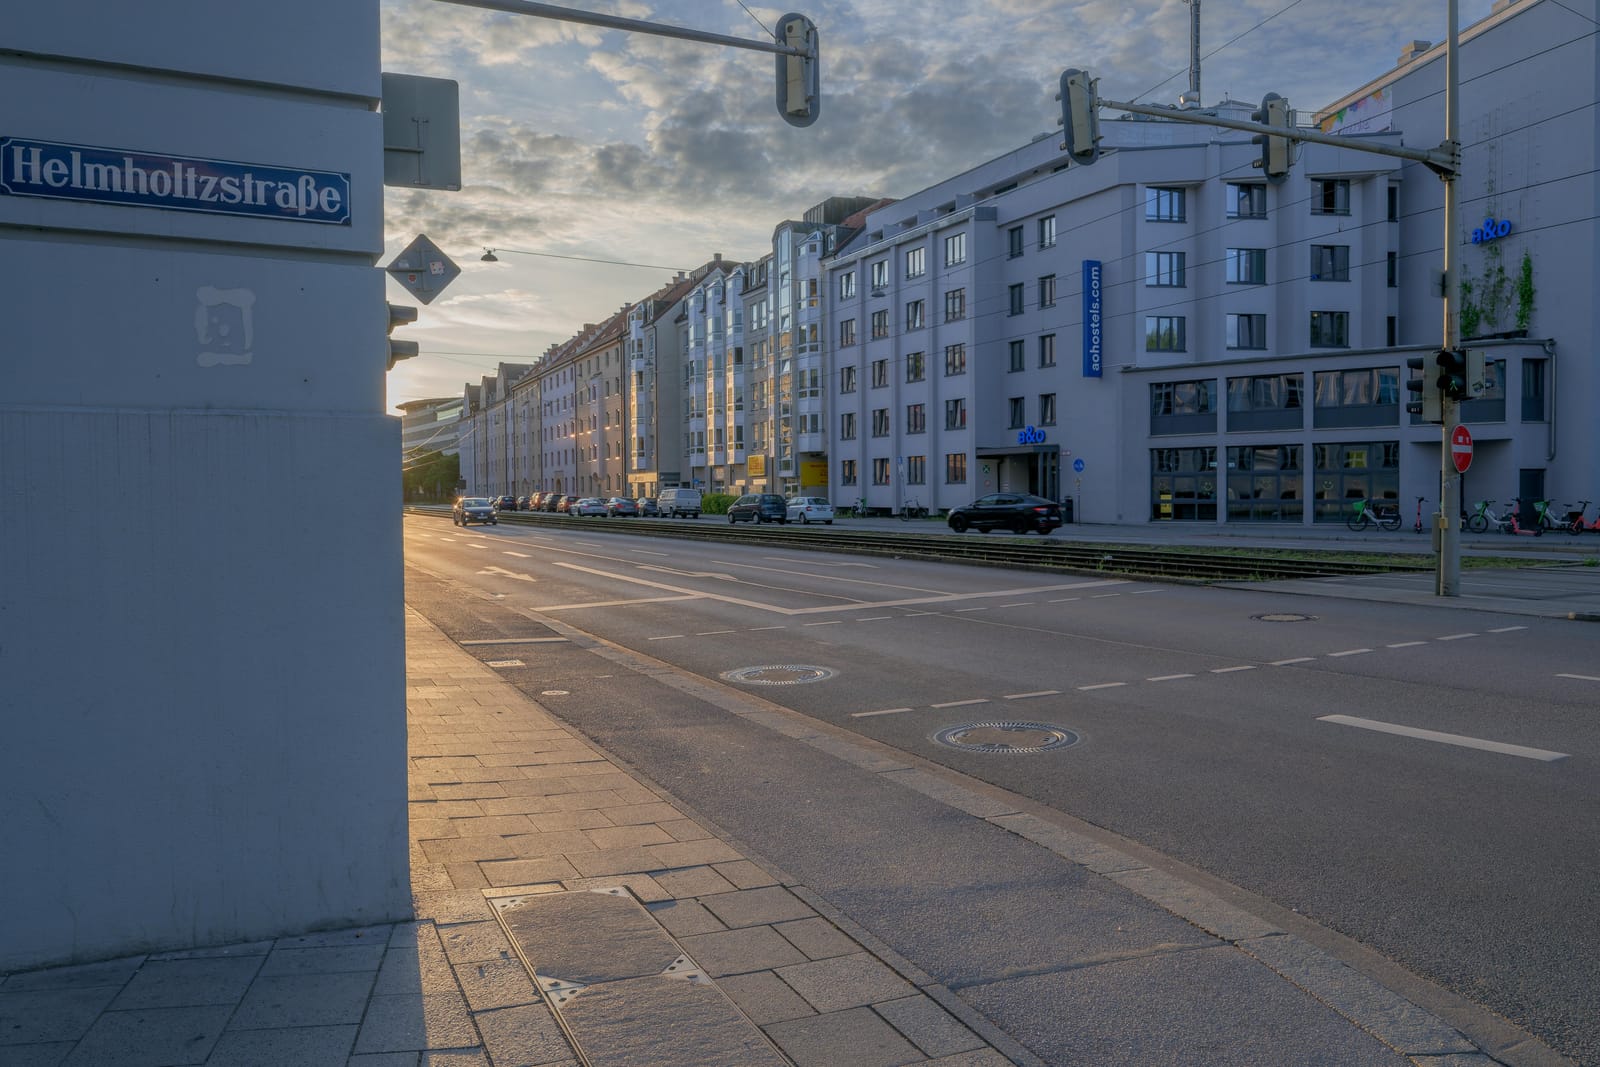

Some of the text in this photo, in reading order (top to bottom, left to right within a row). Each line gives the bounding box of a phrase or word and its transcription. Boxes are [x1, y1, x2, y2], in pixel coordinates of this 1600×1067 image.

[11, 145, 342, 216] Helmholtzstraße
[1471, 217, 1512, 244] a&o
[1089, 266, 1100, 371] aohostels.com
[1017, 425, 1046, 445] a&o
